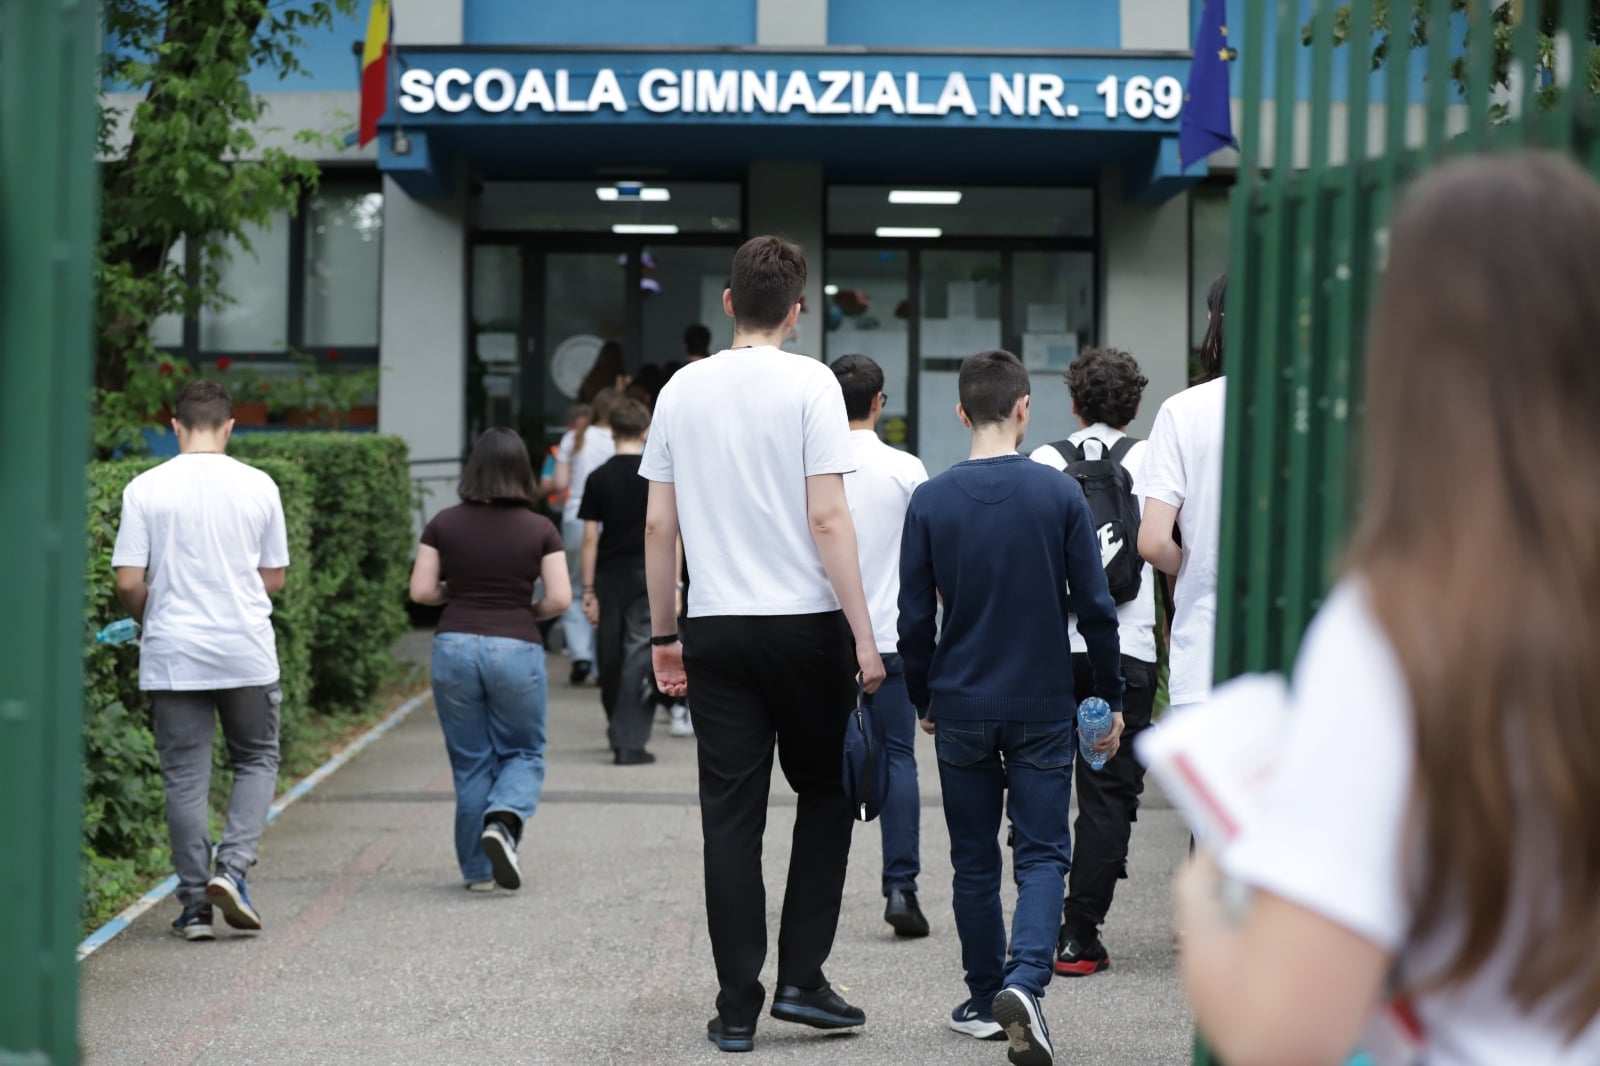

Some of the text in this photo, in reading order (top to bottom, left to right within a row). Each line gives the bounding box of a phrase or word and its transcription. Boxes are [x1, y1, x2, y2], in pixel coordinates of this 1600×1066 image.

[399, 68, 1183, 119] SCOALA GIMNAZIALA NR. 169
